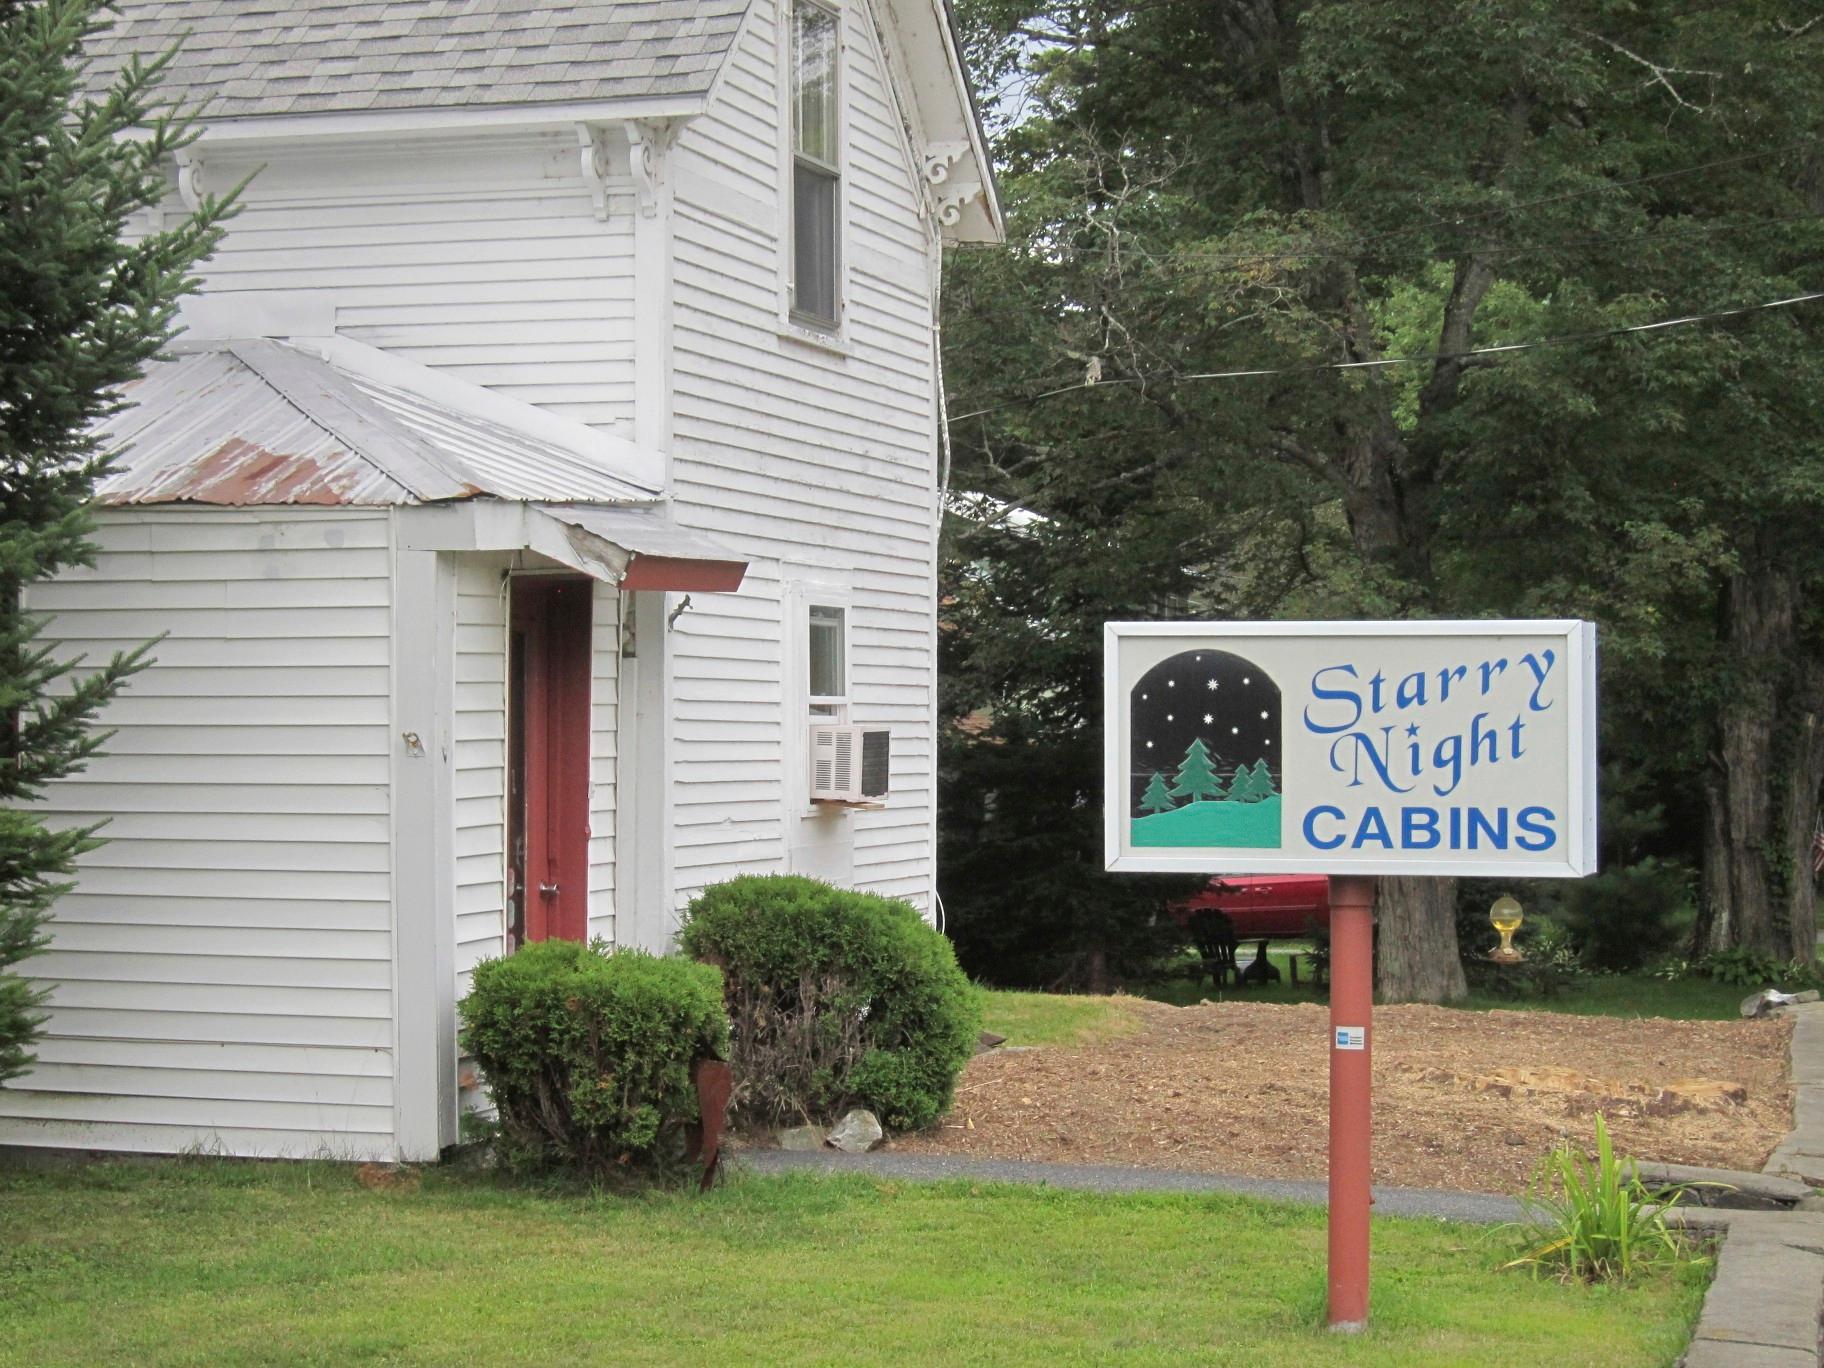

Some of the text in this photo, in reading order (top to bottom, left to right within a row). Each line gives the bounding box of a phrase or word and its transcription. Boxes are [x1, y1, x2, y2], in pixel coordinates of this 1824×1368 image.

[1303, 648, 1556, 734] Starry
[1330, 712, 1527, 797] Night
[1302, 805, 1557, 852] CABINS
